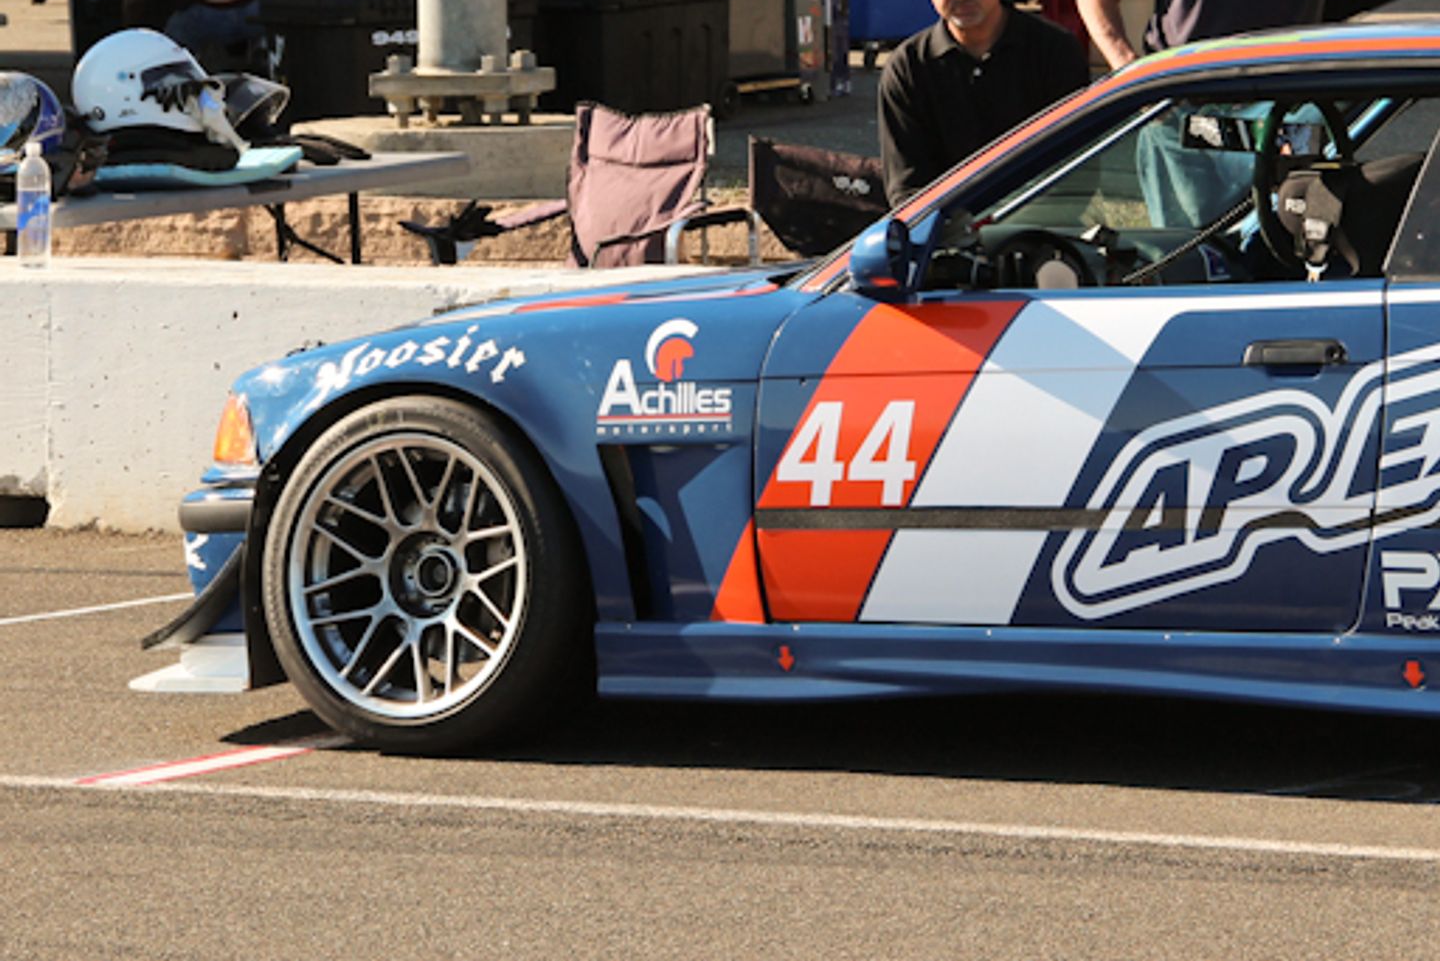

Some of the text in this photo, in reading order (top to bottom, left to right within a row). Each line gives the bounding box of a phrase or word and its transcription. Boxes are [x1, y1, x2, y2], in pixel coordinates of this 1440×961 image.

[306, 324, 527, 410] Hoosier
[596, 358, 732, 416] Achilles
[776, 401, 916, 506] 44
[1387, 613, 1440, 631] Peak
